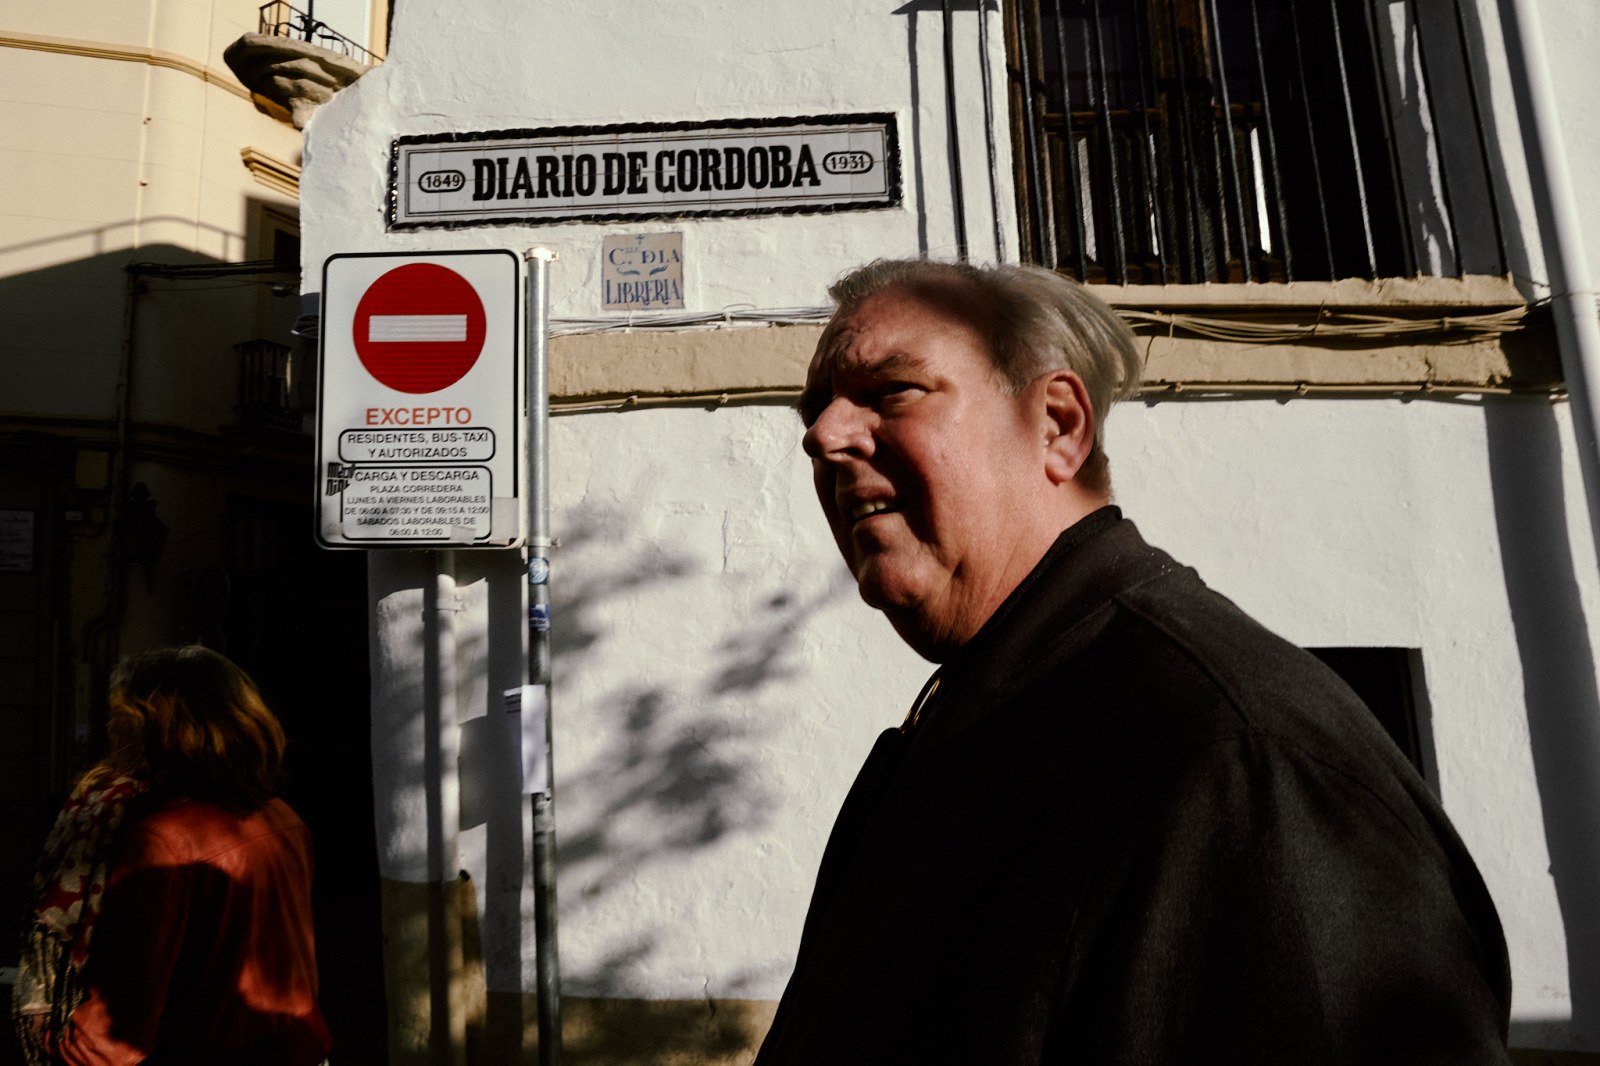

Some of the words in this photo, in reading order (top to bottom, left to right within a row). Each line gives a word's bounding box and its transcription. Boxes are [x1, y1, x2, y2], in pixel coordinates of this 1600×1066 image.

[425, 173, 460, 188] 1849
[472, 153, 596, 201] DIARIO
[602, 151, 648, 195] DE
[655, 144, 820, 193] CORDOBA
[830, 156, 867, 170] 1931
[605, 279, 681, 306] LIBRERIA
[366, 407, 472, 425] EXCEPTO
[348, 433, 429, 444] RESIDENTES,
[432, 432, 488, 442] BUS-TAXI
[368, 449, 376, 458] Y
[378, 448, 468, 458] AUTORIZADOS
[355, 472, 398, 481] CARGA
[400, 472, 408, 480] Y
[411, 471, 479, 480] DESCARGA
[386, 496, 424, 504] VIERNES
[468, 506, 489, 514] 12:00
